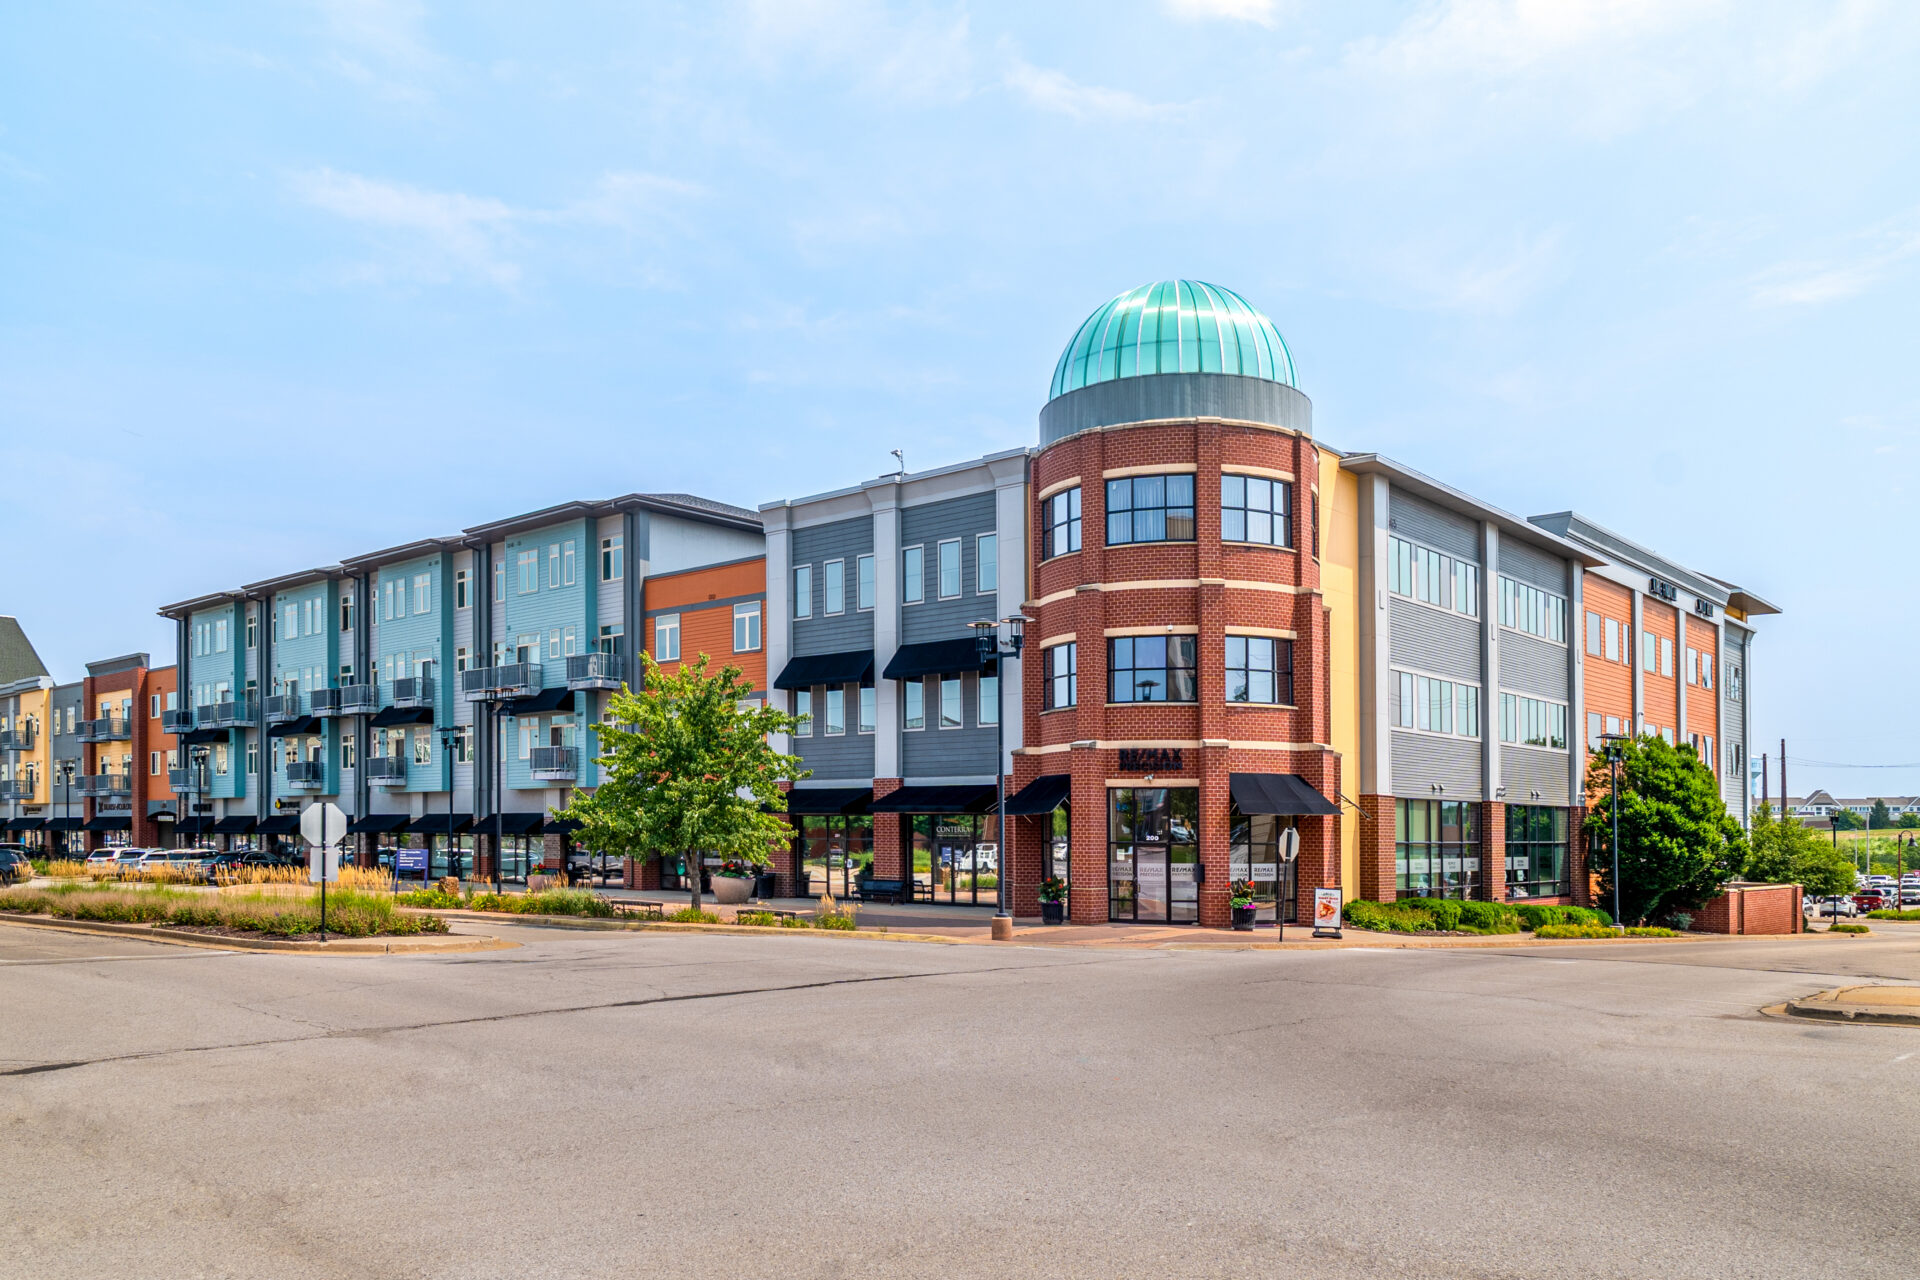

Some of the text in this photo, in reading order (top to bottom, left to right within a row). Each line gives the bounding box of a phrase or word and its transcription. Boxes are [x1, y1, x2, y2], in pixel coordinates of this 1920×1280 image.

[1119, 748, 1181, 760] RE/MAX
[1119, 761, 1183, 771] PRECISION
[936, 825, 970, 833] CONTERRA
